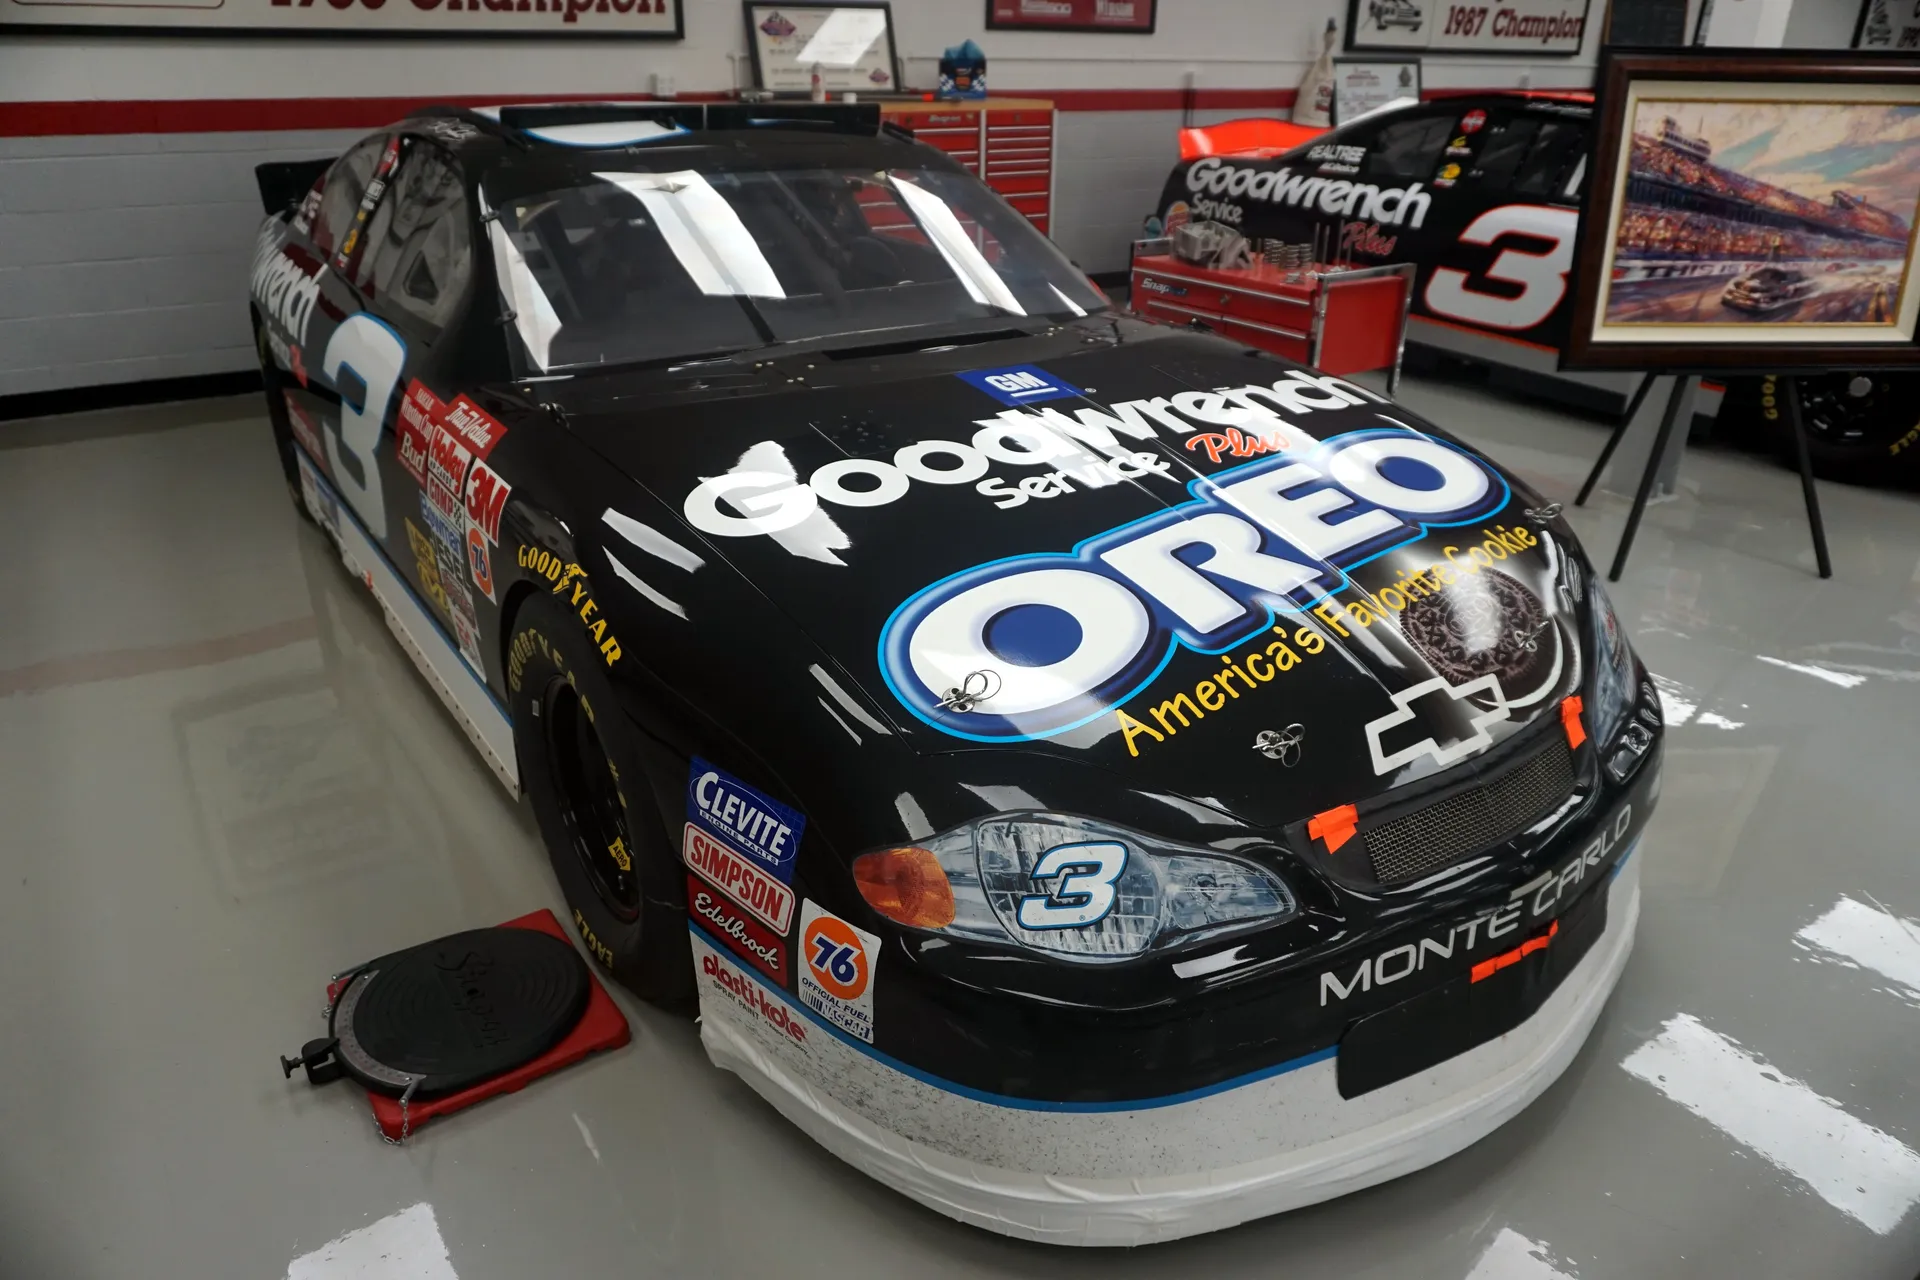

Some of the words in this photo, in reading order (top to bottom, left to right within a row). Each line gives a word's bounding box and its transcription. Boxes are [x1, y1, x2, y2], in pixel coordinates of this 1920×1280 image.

[1444, 5, 1489, 37] 1987
[1492, 8, 1584, 44] Champion
[1307, 145, 1367, 163] REALTREE
[1185, 157, 1432, 230] Goodwrench
[1190, 193, 1243, 223] Service
[1342, 221, 1398, 257] Plus
[1425, 204, 1578, 330] 3
[984, 371, 1049, 392] GM
[322, 315, 405, 540] 3
[401, 431, 427, 473] Bud
[420, 414, 434, 443] Cup
[684, 370, 1372, 538] Goodwrench
[1186, 428, 1291, 464] Plus
[430, 427, 466, 495] Holley
[975, 450, 1172, 509] Service
[429, 479, 453, 517] COMP
[466, 466, 509, 542] 3M
[471, 543, 488, 577] 76
[908, 434, 1490, 716] OREO
[1114, 625, 1325, 757] America's
[1314, 563, 1456, 640] Favorite
[1443, 524, 1537, 576] Cookie
[696, 771, 792, 857] CLEVITE
[700, 810, 740, 841] ENGINE
[742, 837, 779, 866] PARTS
[612, 844, 629, 868] AERO
[690, 831, 785, 923] SIMPSON
[1016, 840, 1129, 931] 3
[1320, 899, 1523, 1006] MONTE
[1532, 803, 1632, 917] CARLO
[694, 892, 780, 971] Edelbrock
[811, 932, 862, 987] 76
[702, 954, 806, 1043] plasti-kote
[713, 980, 736, 1004] SPRAY
[737, 998, 760, 1021] PAINT
[801, 976, 840, 1009] OFFICIAL
[843, 1004, 871, 1024] FUEL
[818, 1002, 871, 1040] NASCAR
[785, 1033, 809, 1055] Company
